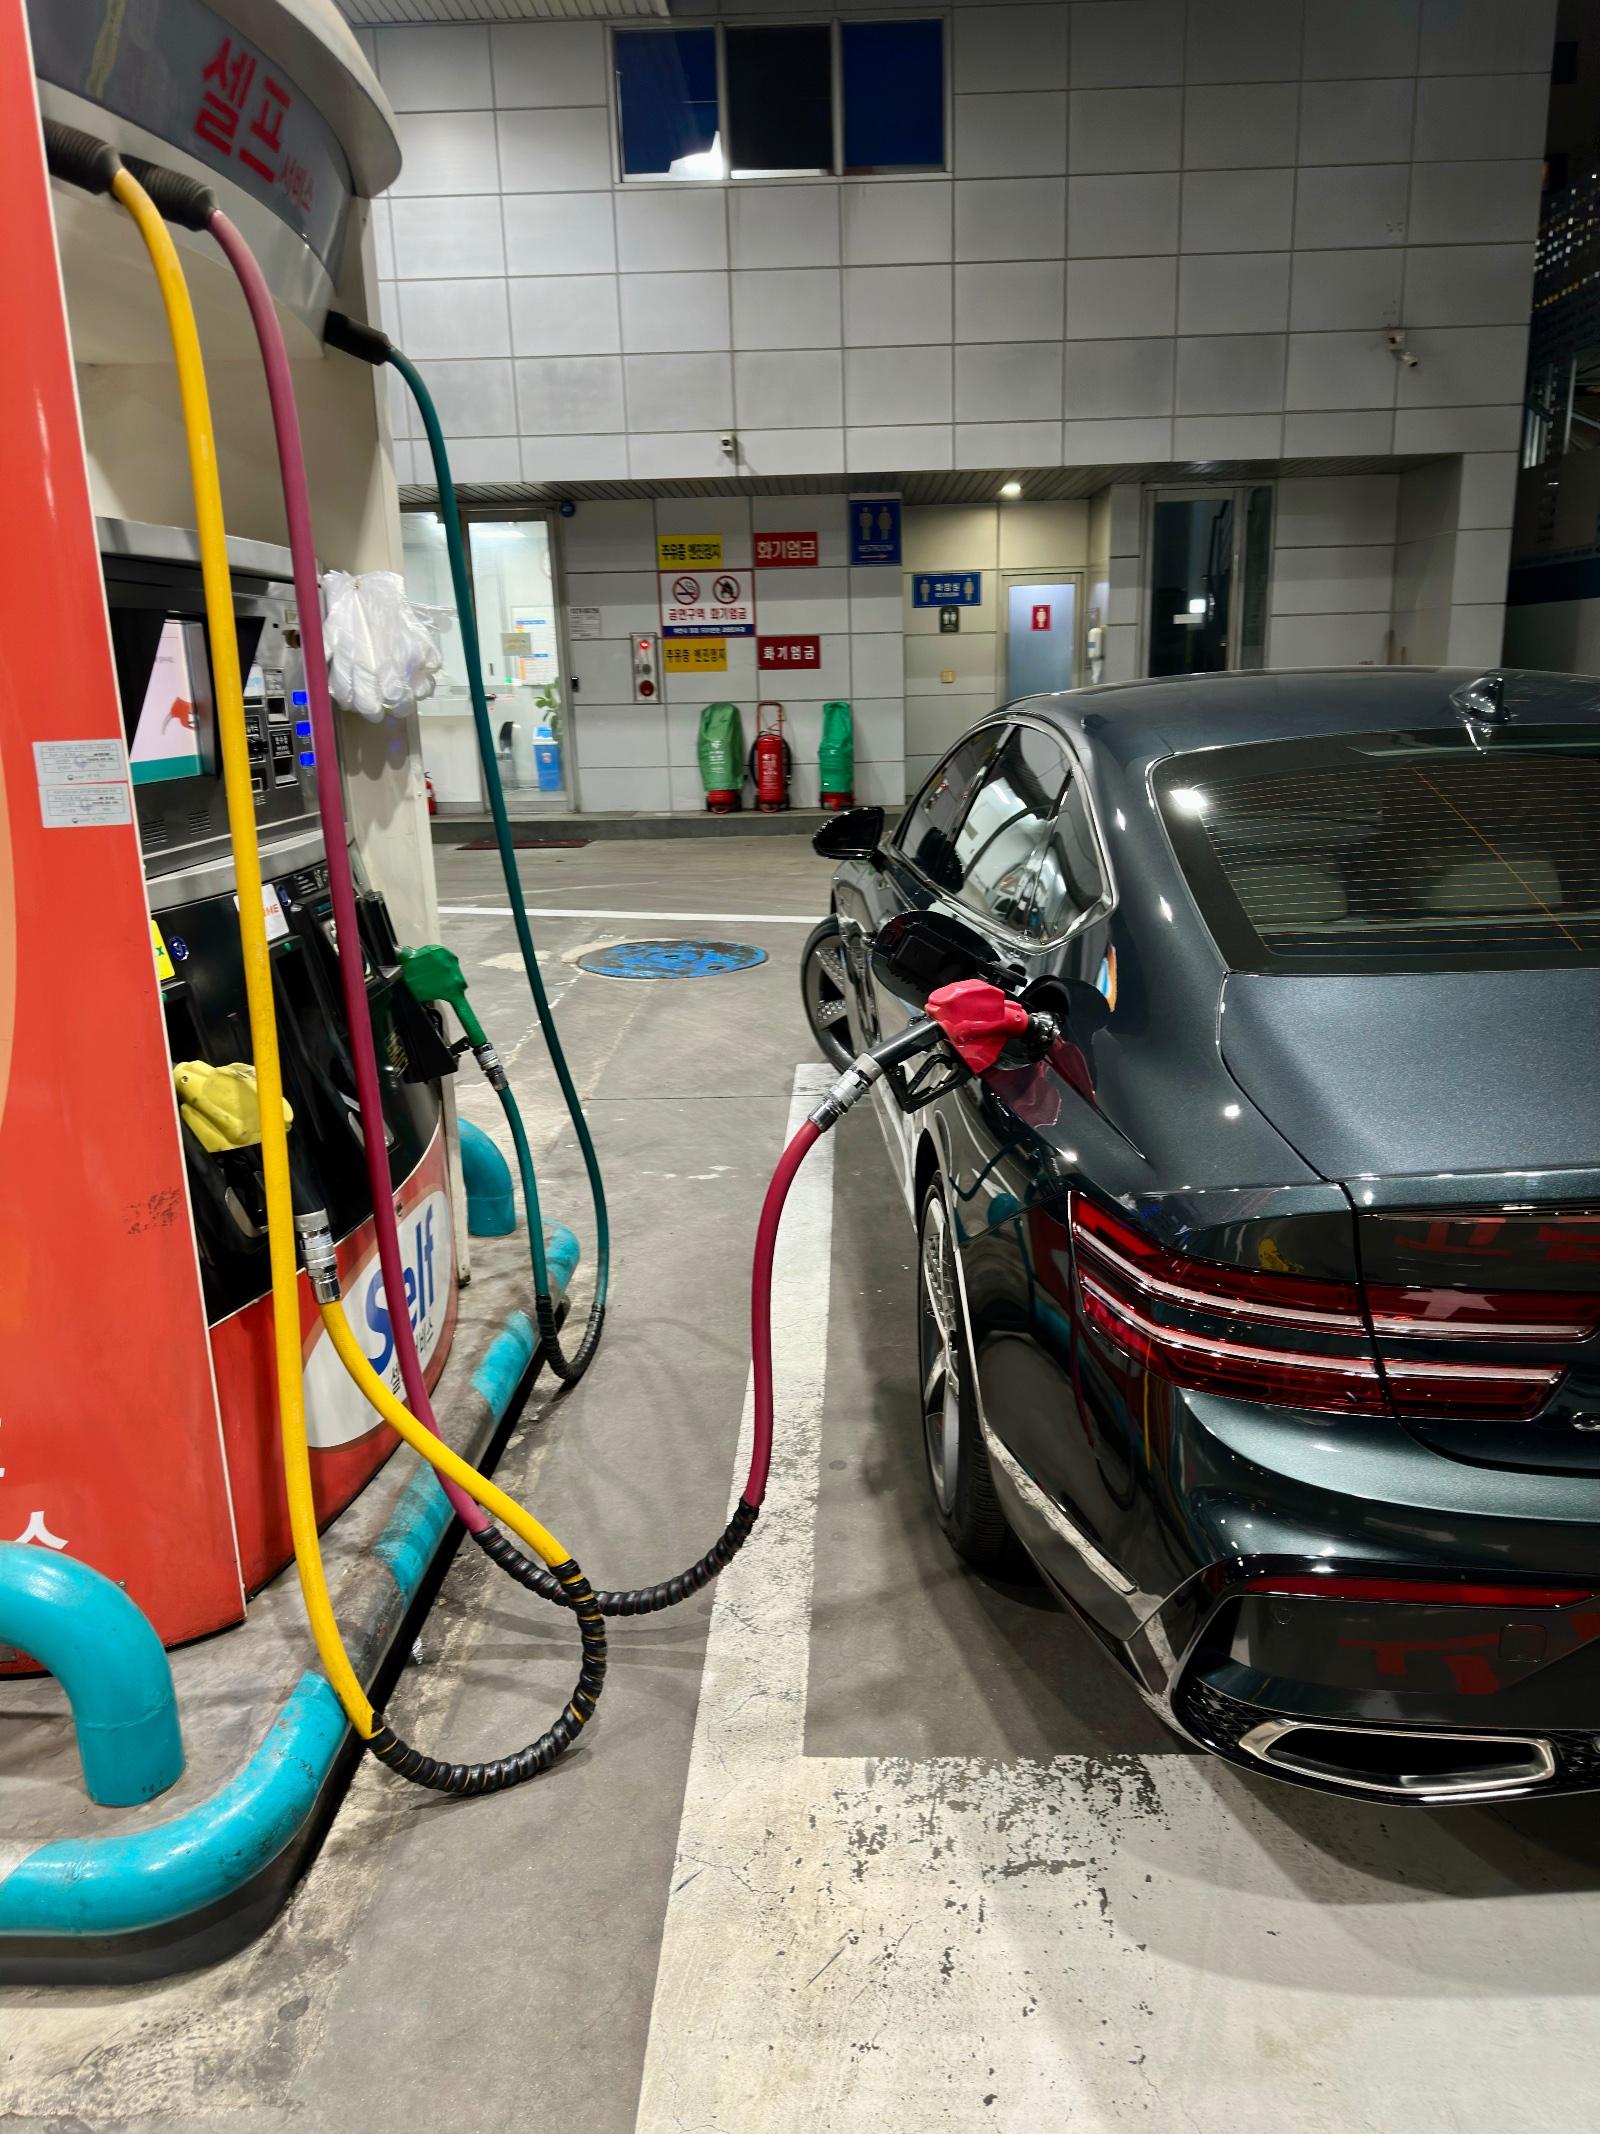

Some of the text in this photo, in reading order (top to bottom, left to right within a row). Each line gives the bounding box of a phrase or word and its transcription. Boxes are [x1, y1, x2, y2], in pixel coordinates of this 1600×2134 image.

[193, 36, 292, 184] 셀프
[661, 543, 721, 561] 주유중 엔진정지
[757, 540, 816, 559] 화기엄금
[668, 607, 747, 621] 금연구역 화기엄금
[666, 648, 726, 663] 주유중 엔진정지
[763, 645, 816, 660] 화기엄금
[365, 1204, 434, 1376] Self
